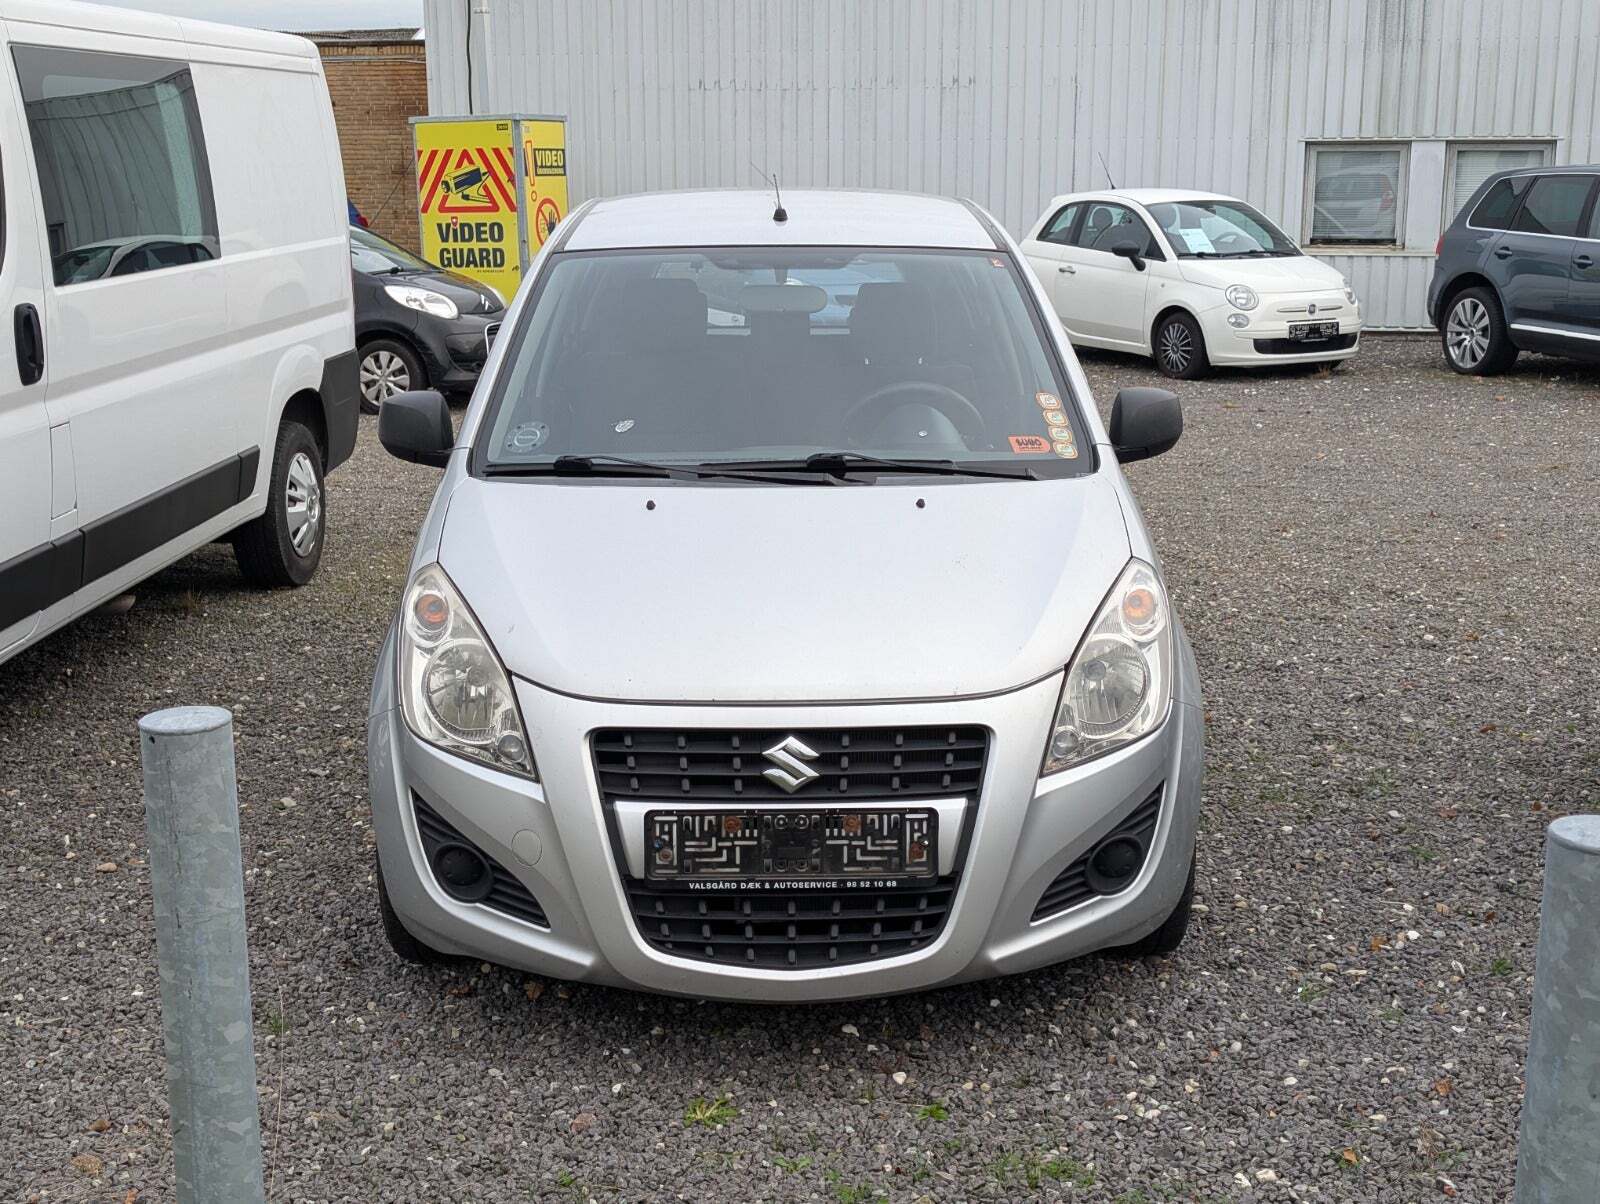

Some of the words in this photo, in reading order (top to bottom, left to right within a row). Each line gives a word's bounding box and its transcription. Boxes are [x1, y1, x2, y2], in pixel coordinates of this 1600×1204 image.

[536, 150, 564, 167] VIDEO
[439, 247, 505, 268] GUARD
[689, 881, 737, 889] VALSGÅRD
[773, 881, 838, 889] AUTOSERVICE
[874, 880, 884, 888] 10
[886, 880, 897, 888] 68
